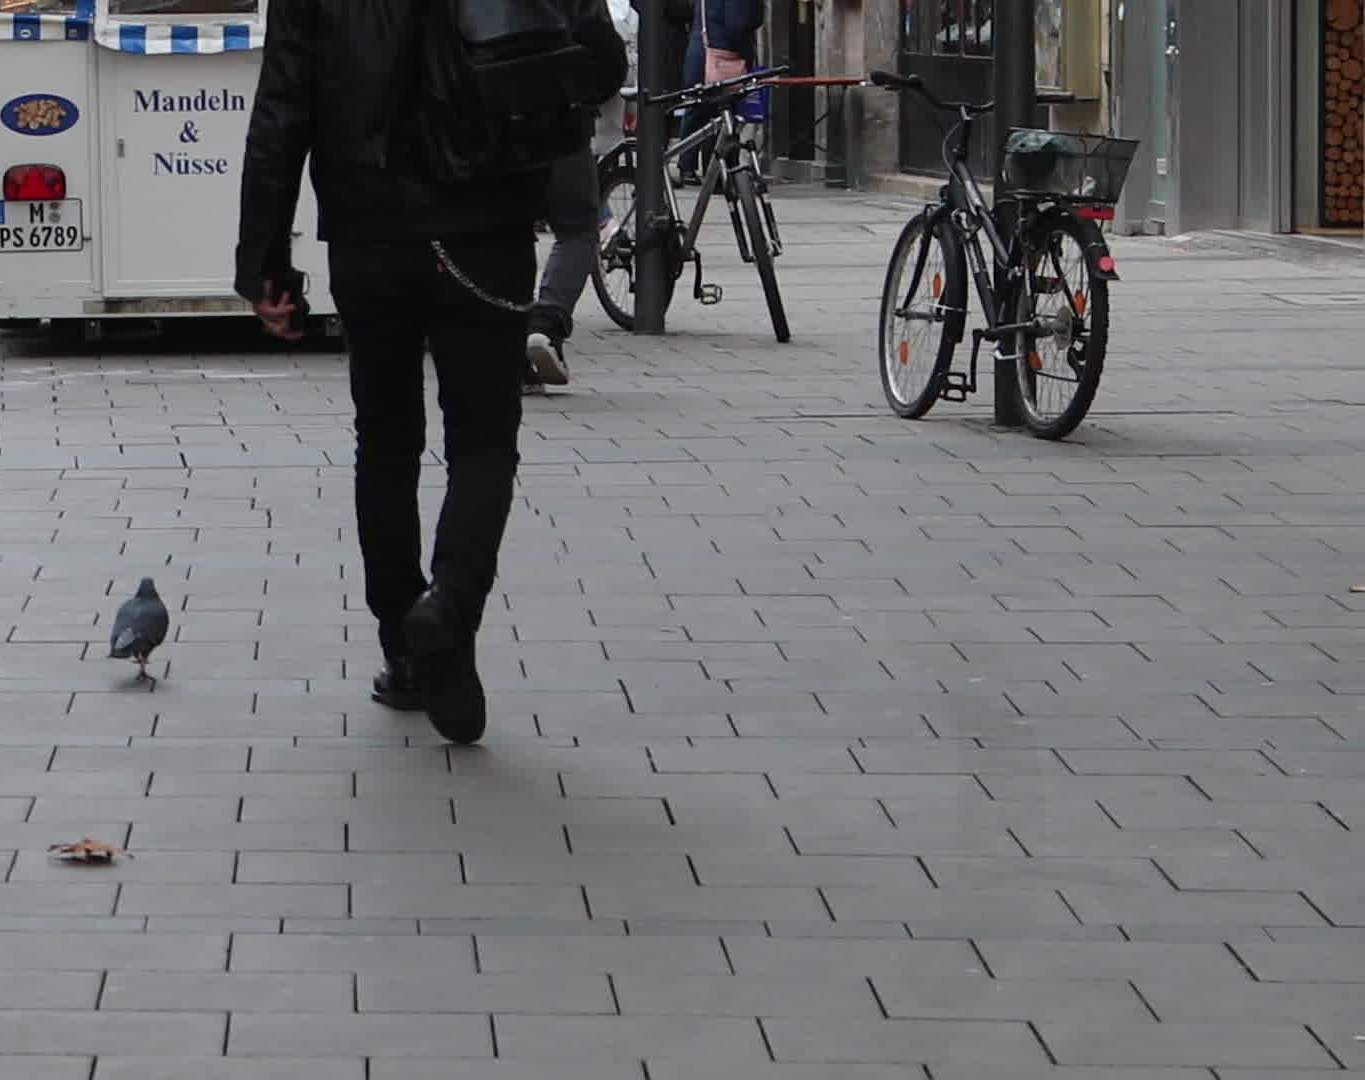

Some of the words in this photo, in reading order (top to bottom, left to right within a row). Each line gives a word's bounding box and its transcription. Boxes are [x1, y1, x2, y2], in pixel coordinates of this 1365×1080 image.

[133, 88, 246, 113] Mandeln
[179, 119, 200, 144] &
[153, 151, 229, 176] Nüsse
[29, 202, 44, 224] M
[0, 226, 24, 248] PS
[29, 225, 78, 248] 6789
